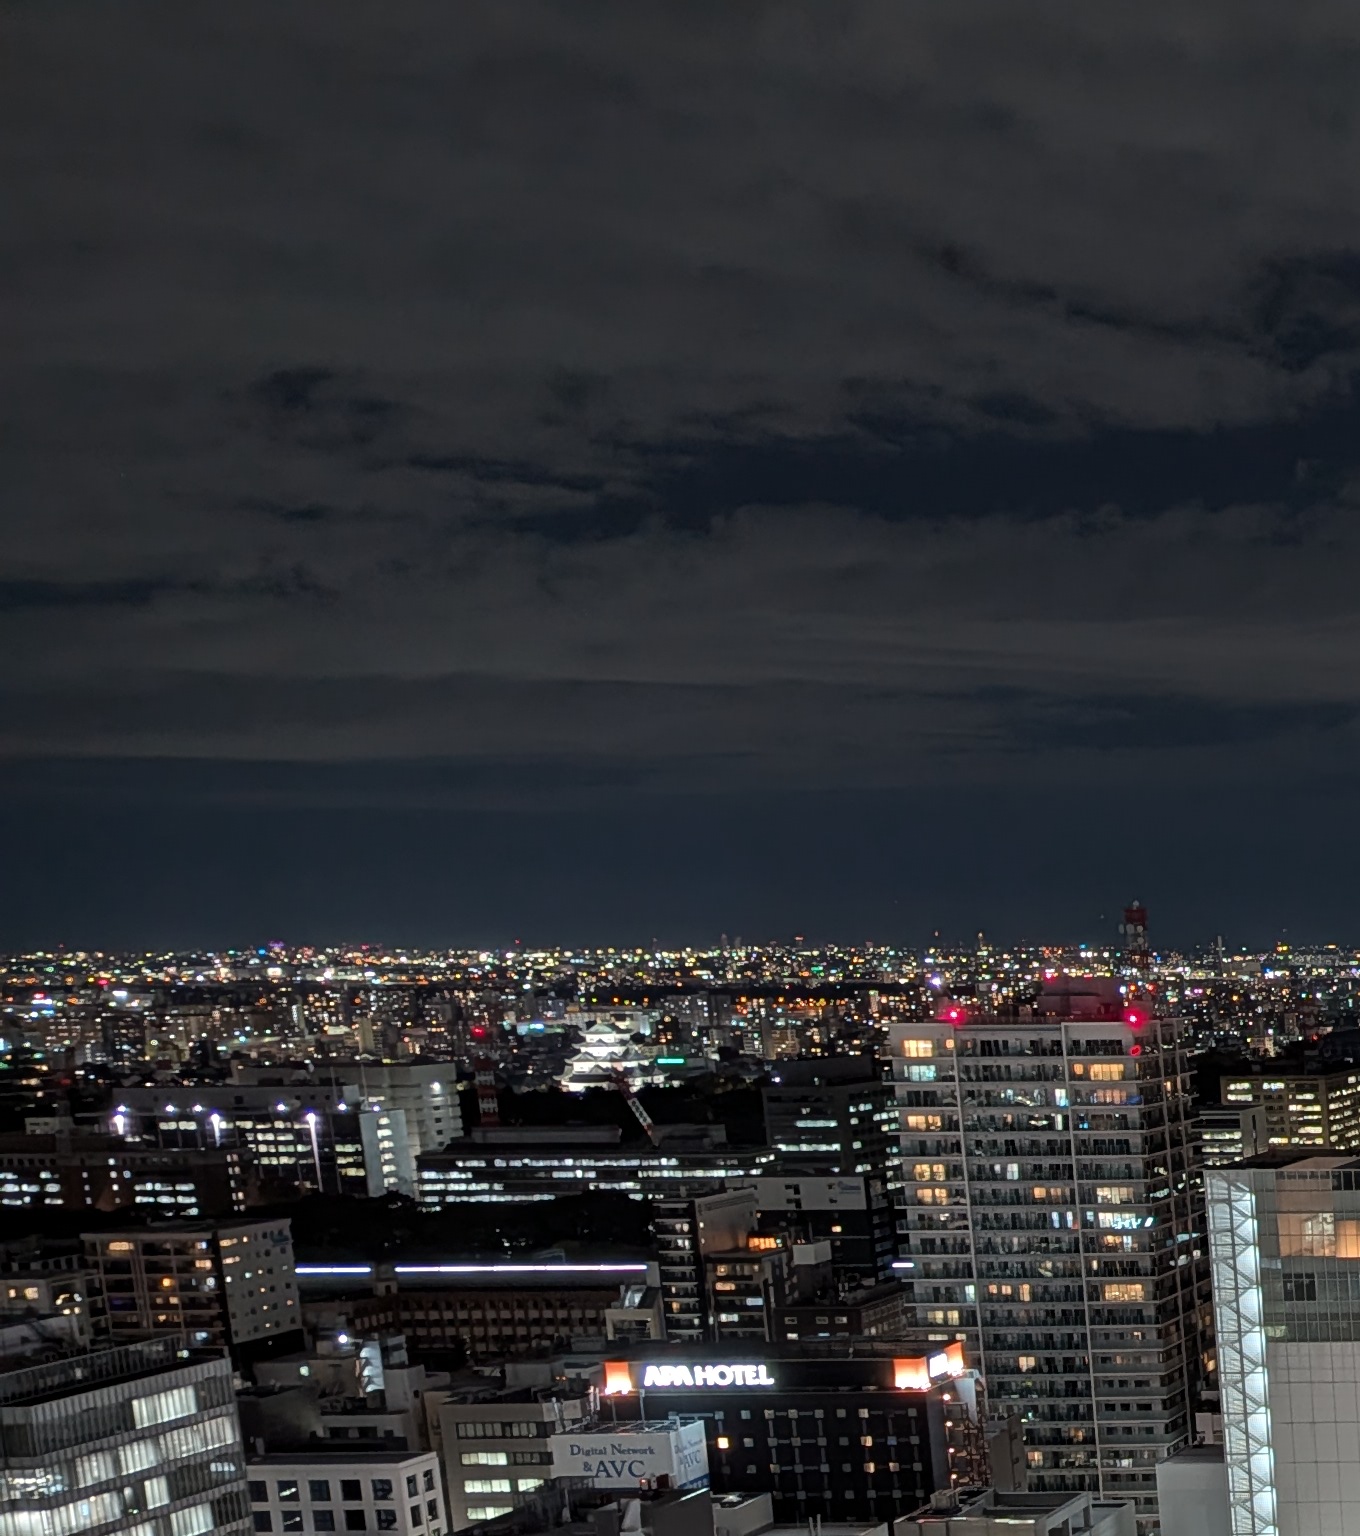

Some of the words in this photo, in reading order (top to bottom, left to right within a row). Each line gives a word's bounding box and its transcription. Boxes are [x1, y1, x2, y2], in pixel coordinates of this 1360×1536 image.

[643, 1365, 694, 1387] APA
[694, 1364, 775, 1386] HOTEL
[569, 1444, 607, 1457] Digital
[610, 1443, 656, 1456] Network
